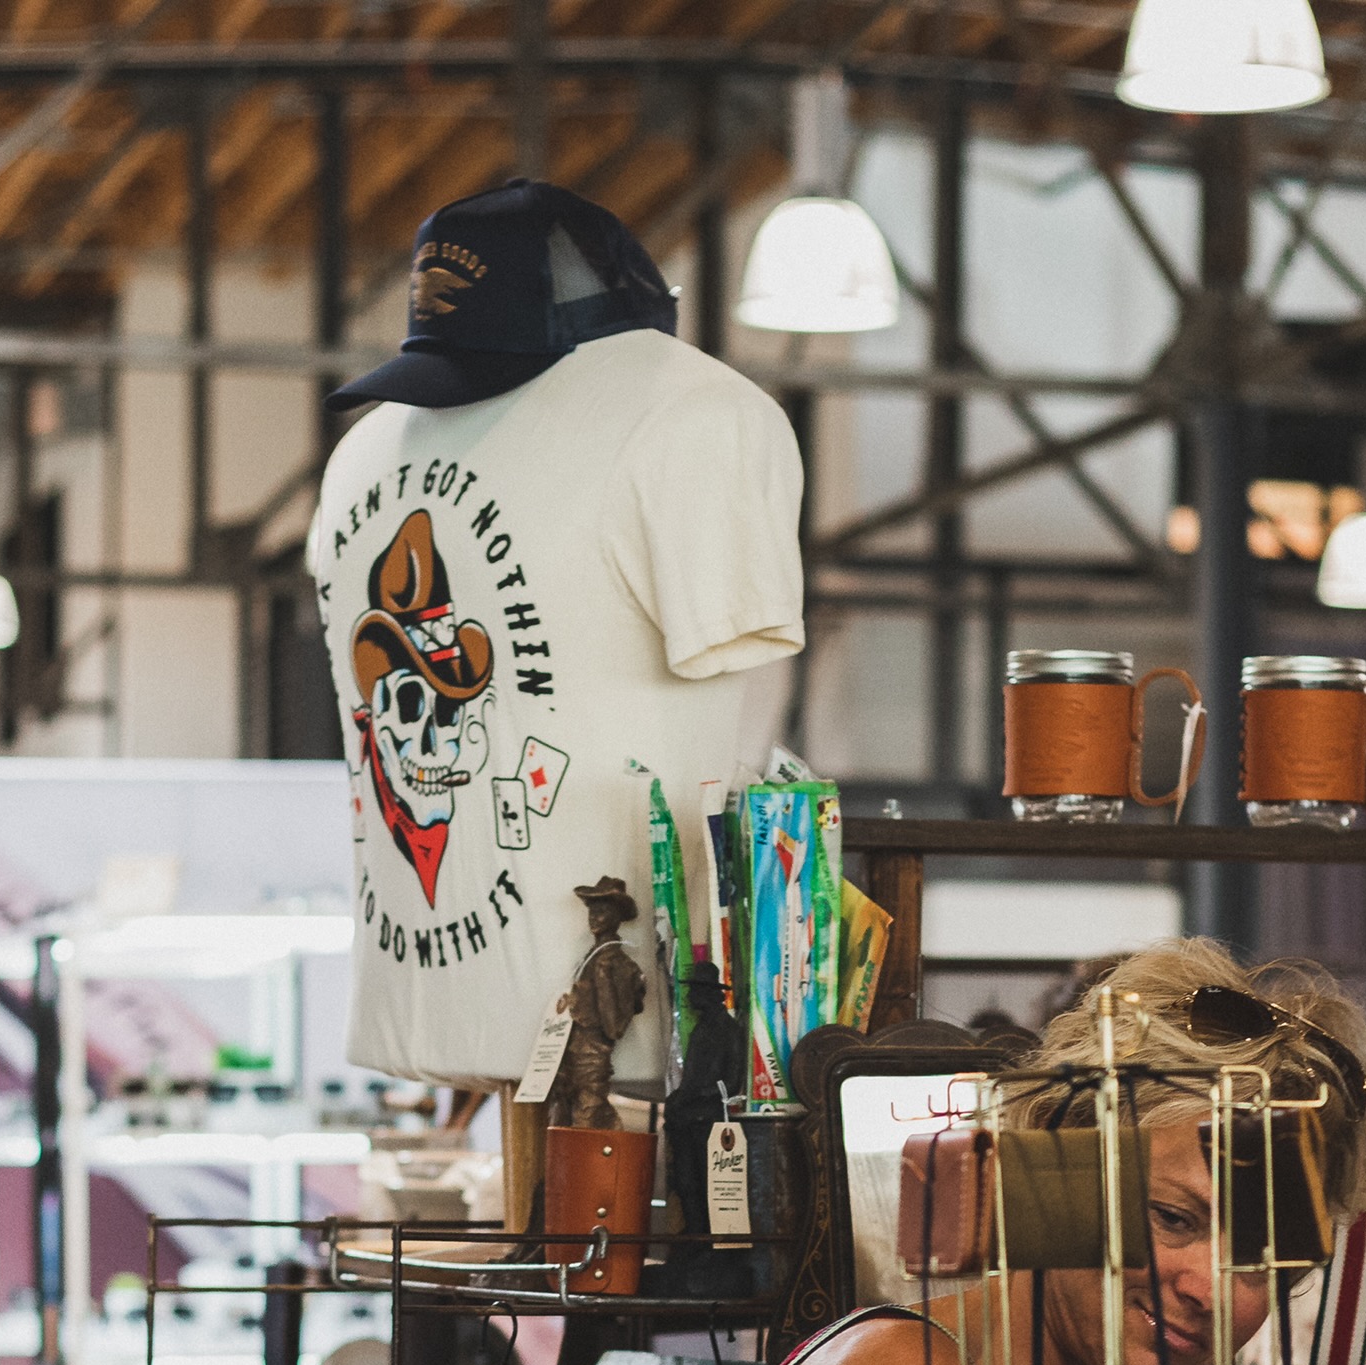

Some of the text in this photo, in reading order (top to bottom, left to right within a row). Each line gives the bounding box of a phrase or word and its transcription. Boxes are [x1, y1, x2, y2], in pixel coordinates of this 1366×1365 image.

[423, 458, 478, 506] GOT
[379, 912, 406, 963] DO
[415, 911, 487, 968] WITH
[488, 869, 523, 929] IT
